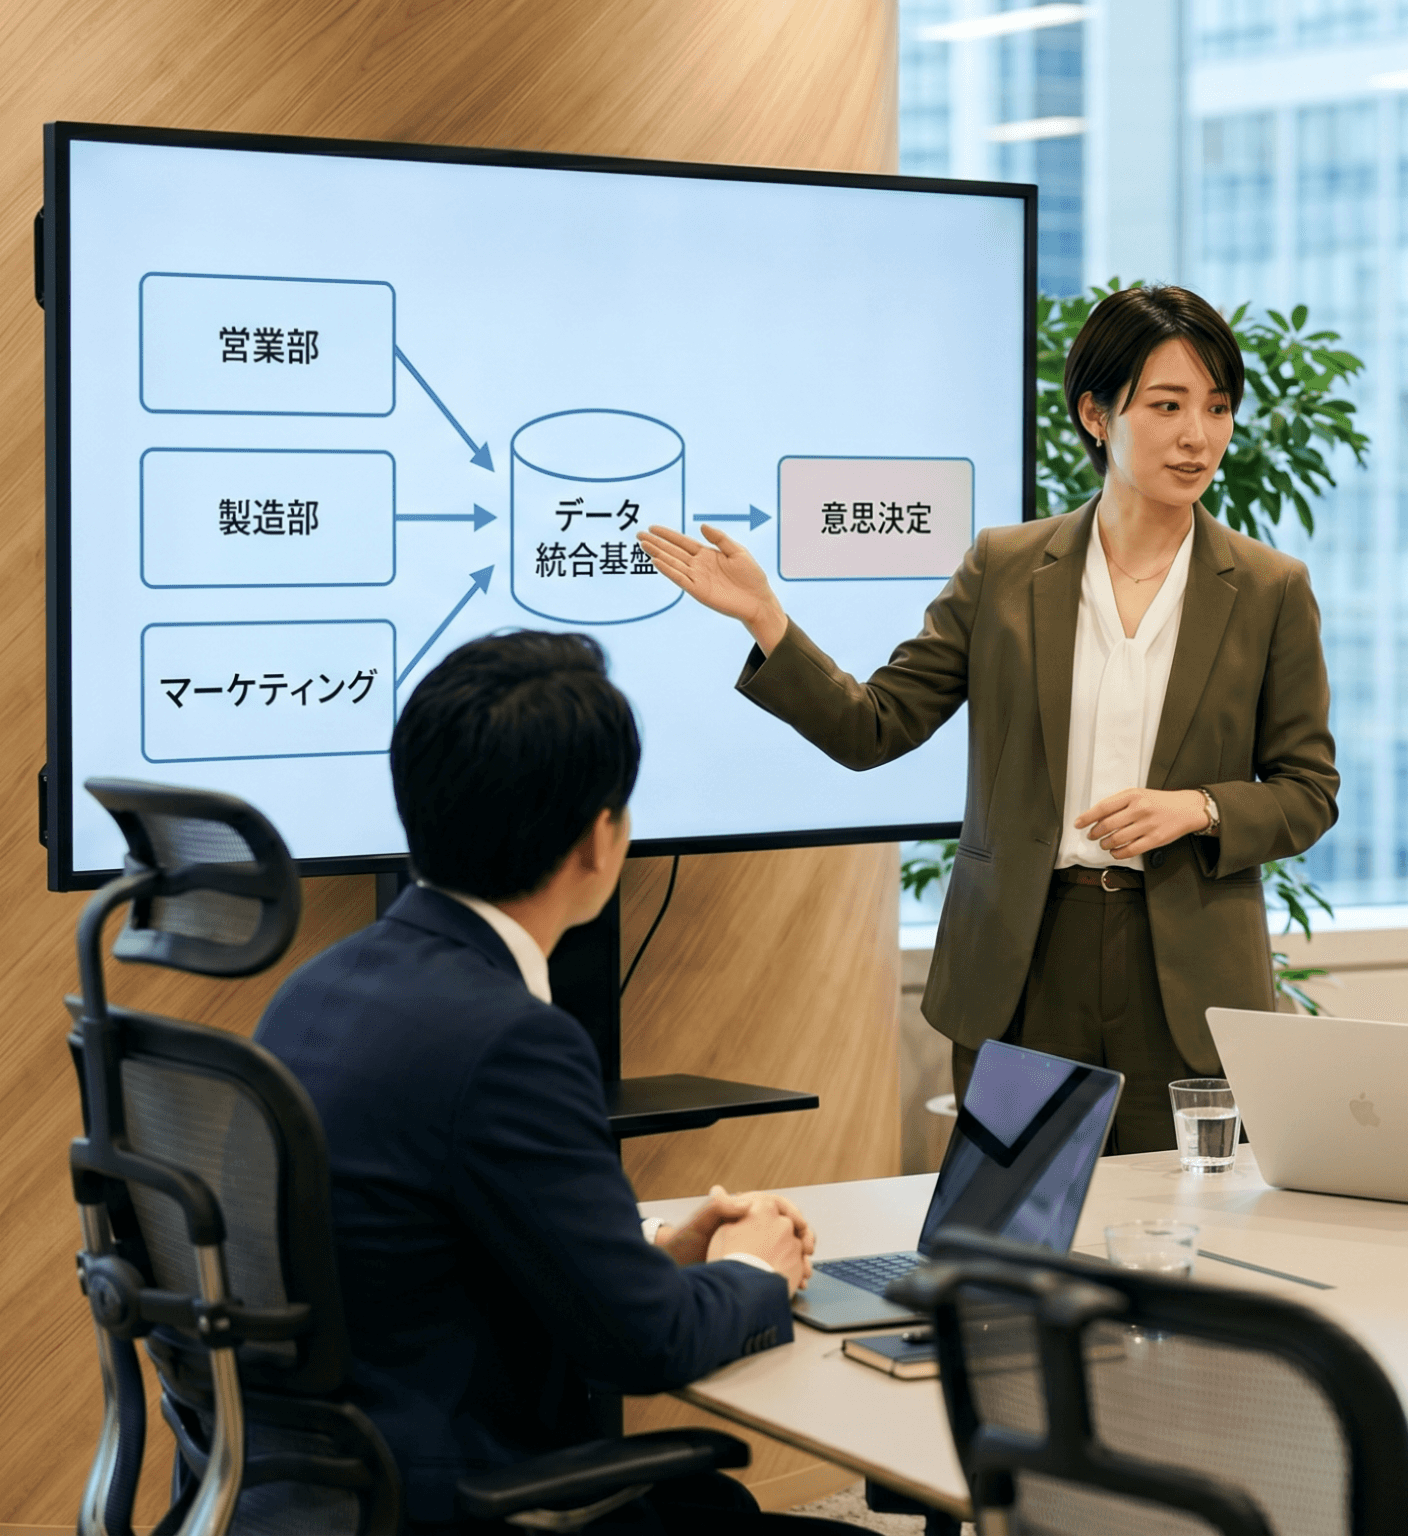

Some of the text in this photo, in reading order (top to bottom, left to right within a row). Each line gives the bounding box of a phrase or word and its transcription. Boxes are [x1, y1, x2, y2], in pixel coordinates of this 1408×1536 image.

[219, 326, 319, 365] 営業部
[218, 498, 319, 536] 製造部
[555, 497, 640, 532] データ
[821, 501, 932, 535] 意思決定
[535, 541, 659, 578] 統合基盤
[160, 668, 378, 709] マーケティング
